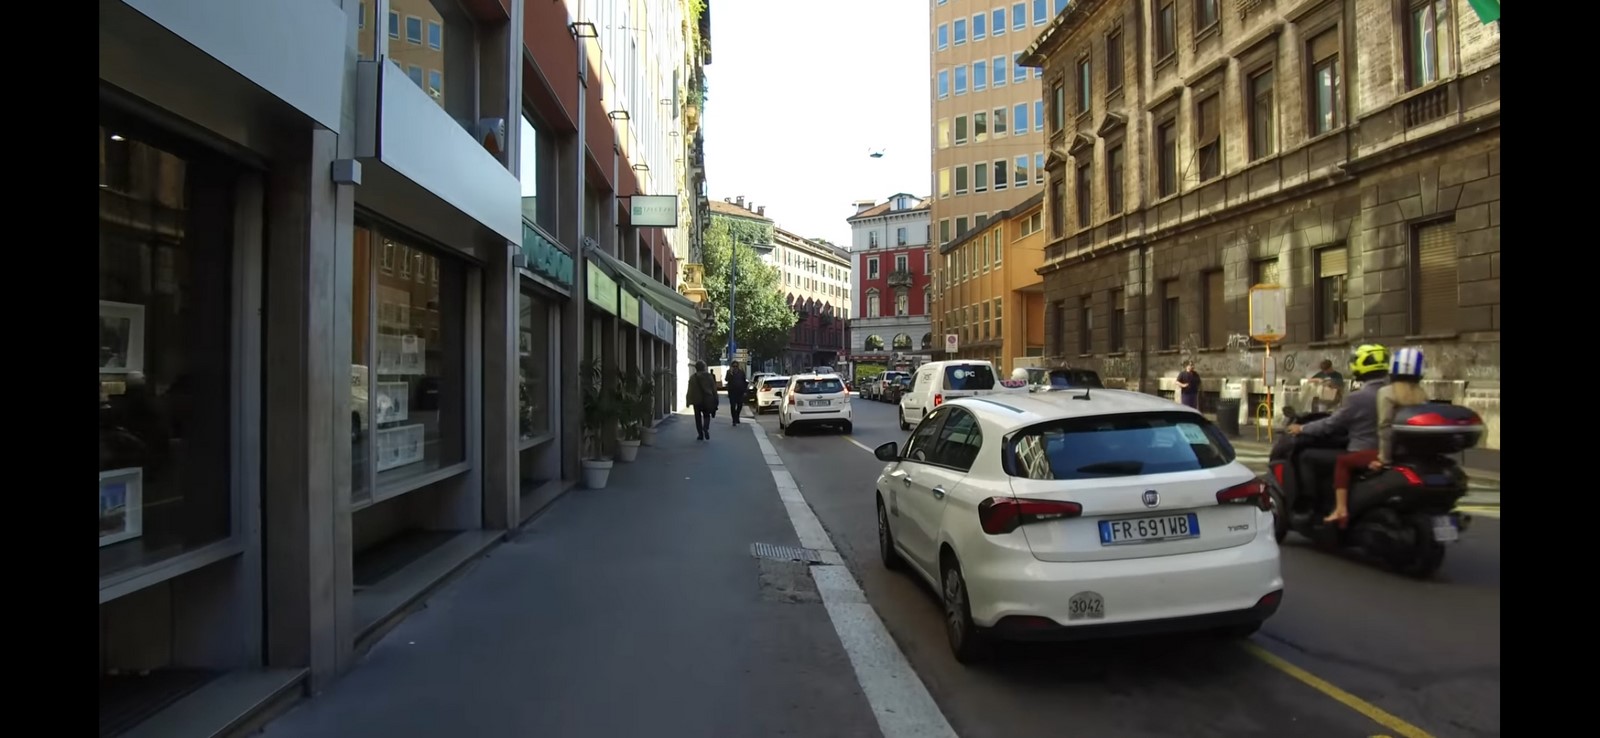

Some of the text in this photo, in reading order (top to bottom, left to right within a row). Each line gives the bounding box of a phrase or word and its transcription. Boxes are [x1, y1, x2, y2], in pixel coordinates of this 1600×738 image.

[965, 370, 975, 378] PC
[1111, 516, 1189, 540] FR 691WB
[1228, 523, 1249, 533] TIPO
[1072, 597, 1101, 614] 3042
